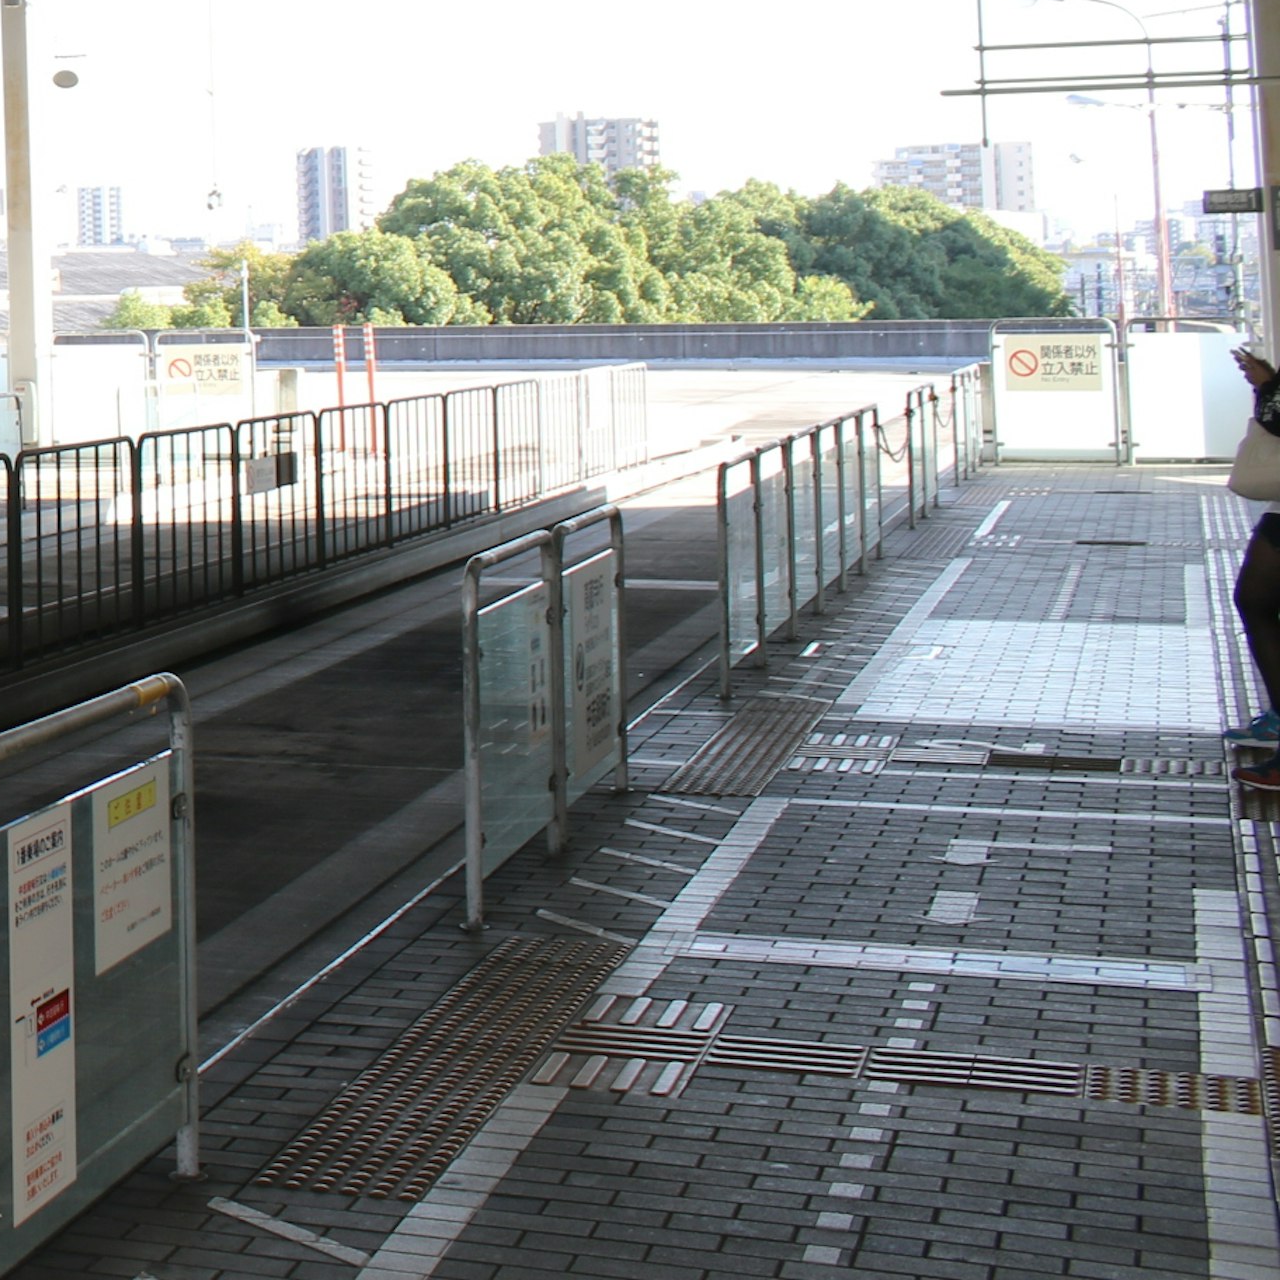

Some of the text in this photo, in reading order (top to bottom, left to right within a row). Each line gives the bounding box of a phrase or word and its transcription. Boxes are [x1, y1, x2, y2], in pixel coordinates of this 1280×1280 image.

[1039, 344, 1097, 359] 関係者以外
[193, 353, 239, 367] 関係者以外
[194, 368, 241, 382] 立入禁止
[1041, 361, 1099, 376] 立入禁止
